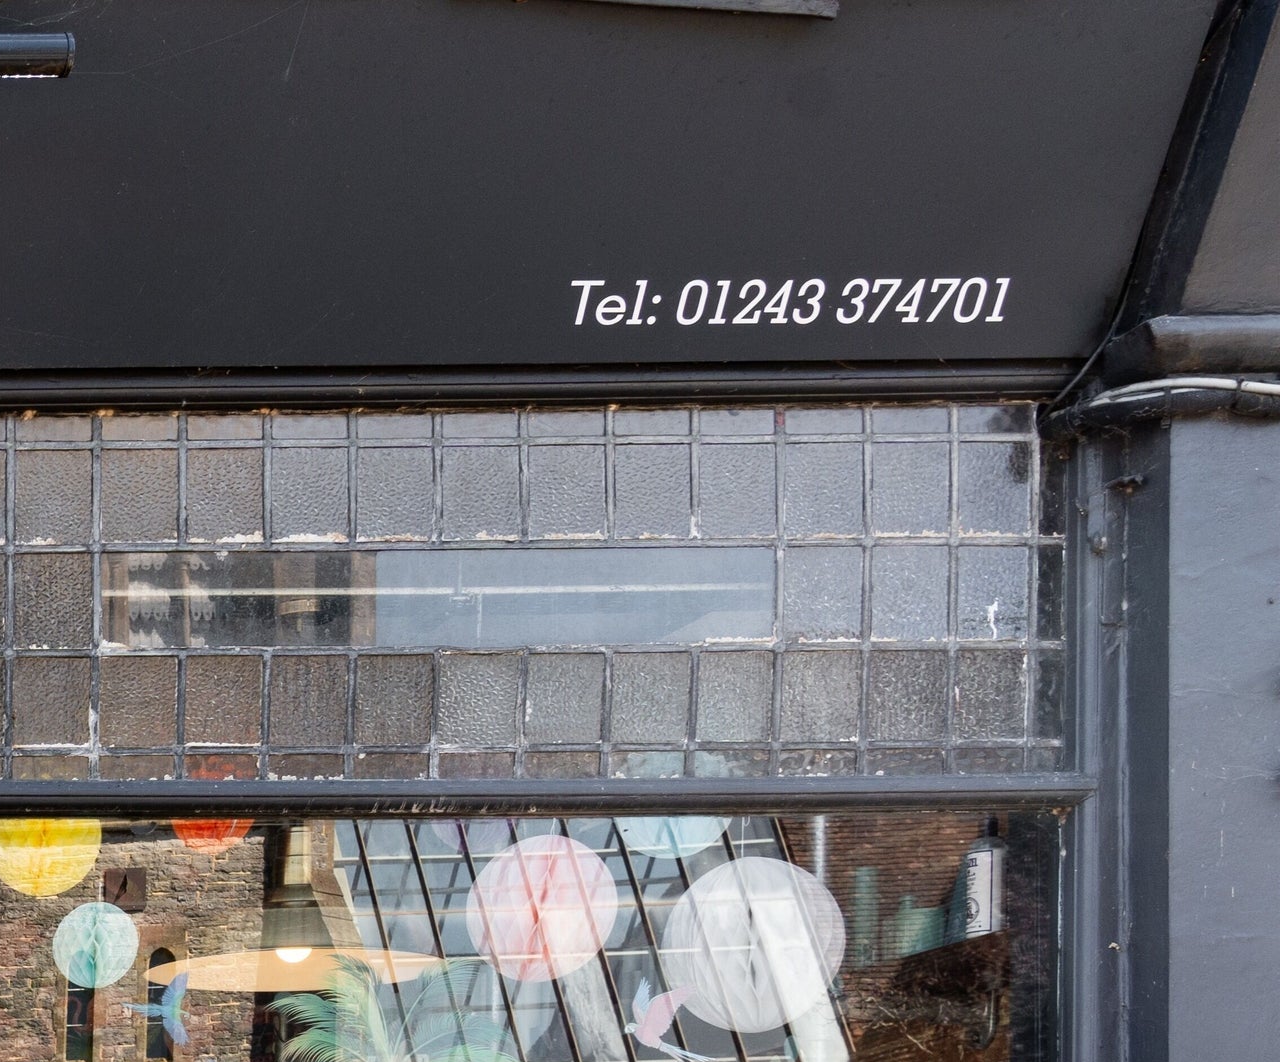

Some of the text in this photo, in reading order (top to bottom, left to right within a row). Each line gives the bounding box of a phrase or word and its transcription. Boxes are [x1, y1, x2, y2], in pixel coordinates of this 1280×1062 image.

[570, 276, 1011, 326] Tel: 01243 374701
